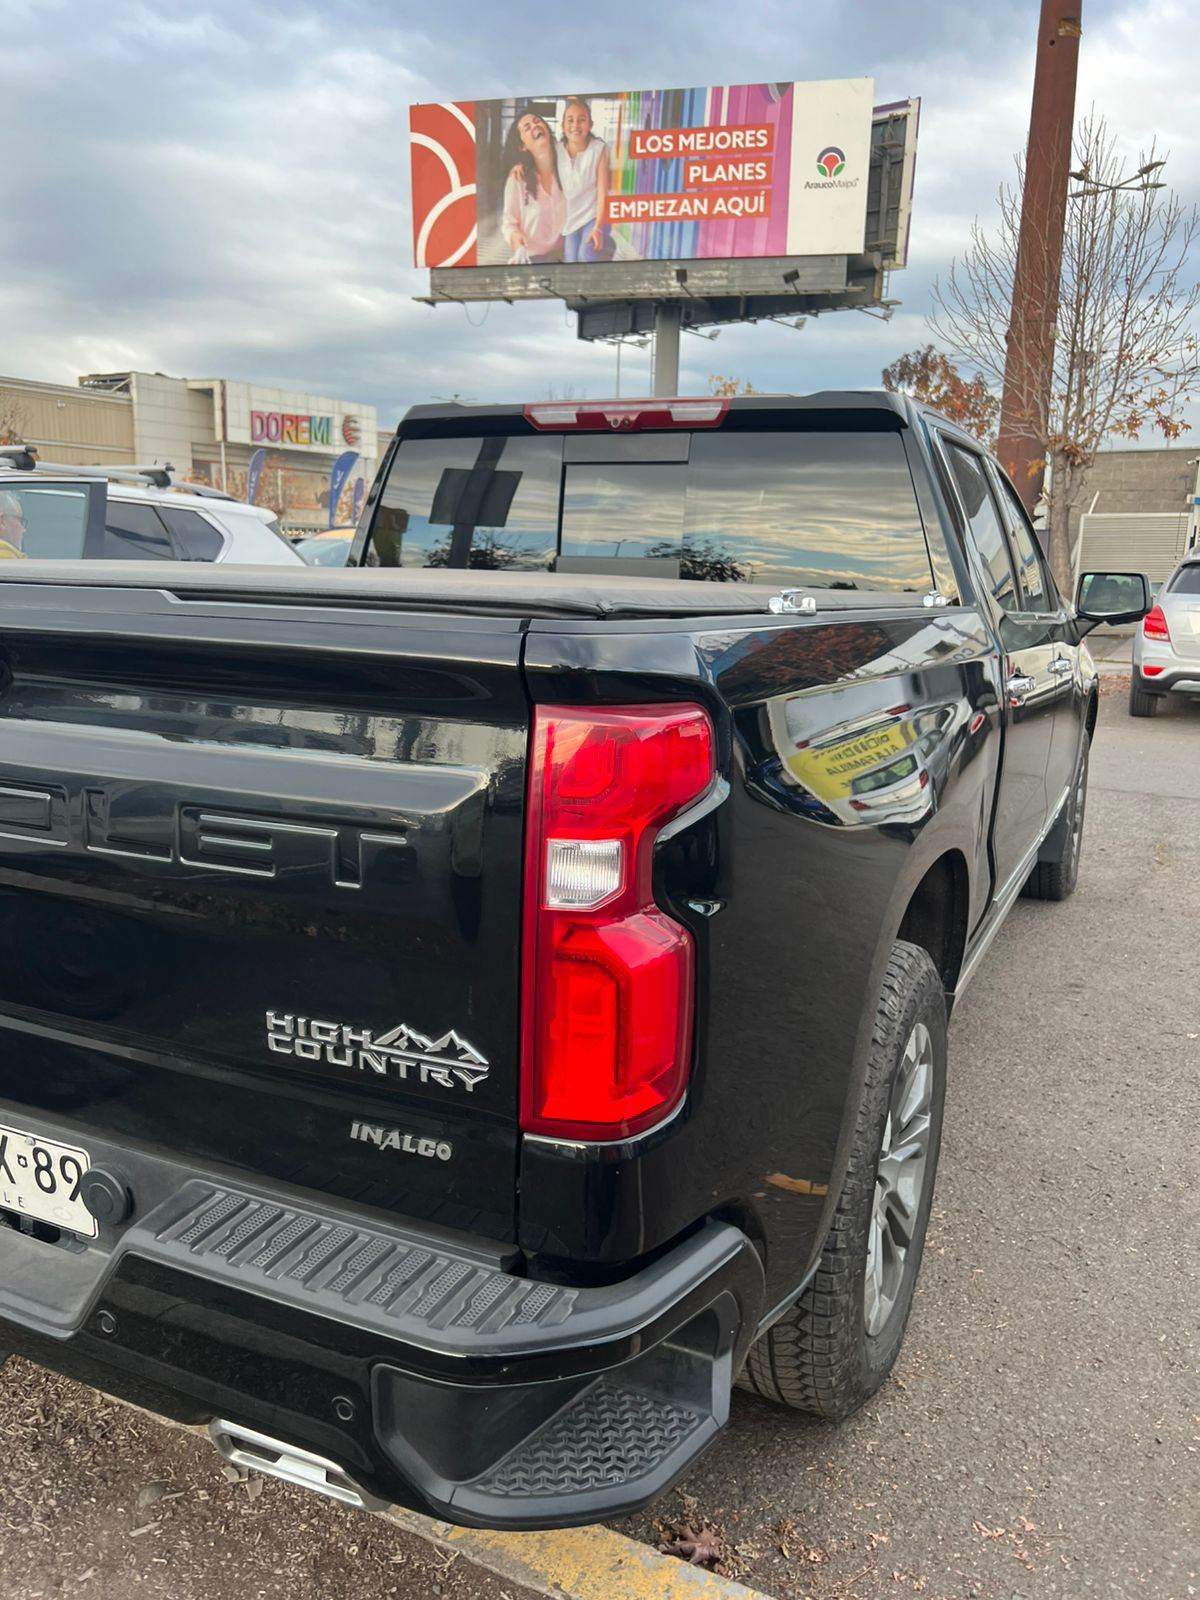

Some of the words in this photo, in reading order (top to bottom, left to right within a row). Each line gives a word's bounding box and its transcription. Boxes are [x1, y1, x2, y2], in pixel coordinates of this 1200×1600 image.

[635, 134, 674, 153] LOS
[678, 129, 768, 152] MEJORES
[688, 162, 767, 183] PLANES
[609, 198, 708, 218] EMPIEZAN
[712, 190, 766, 216] AQUÍ
[250, 409, 333, 445] DOREMI
[266, 1010, 373, 1049] HIGH
[267, 1032, 489, 1092] COUNTRY
[350, 1122, 452, 1161] INALCO
